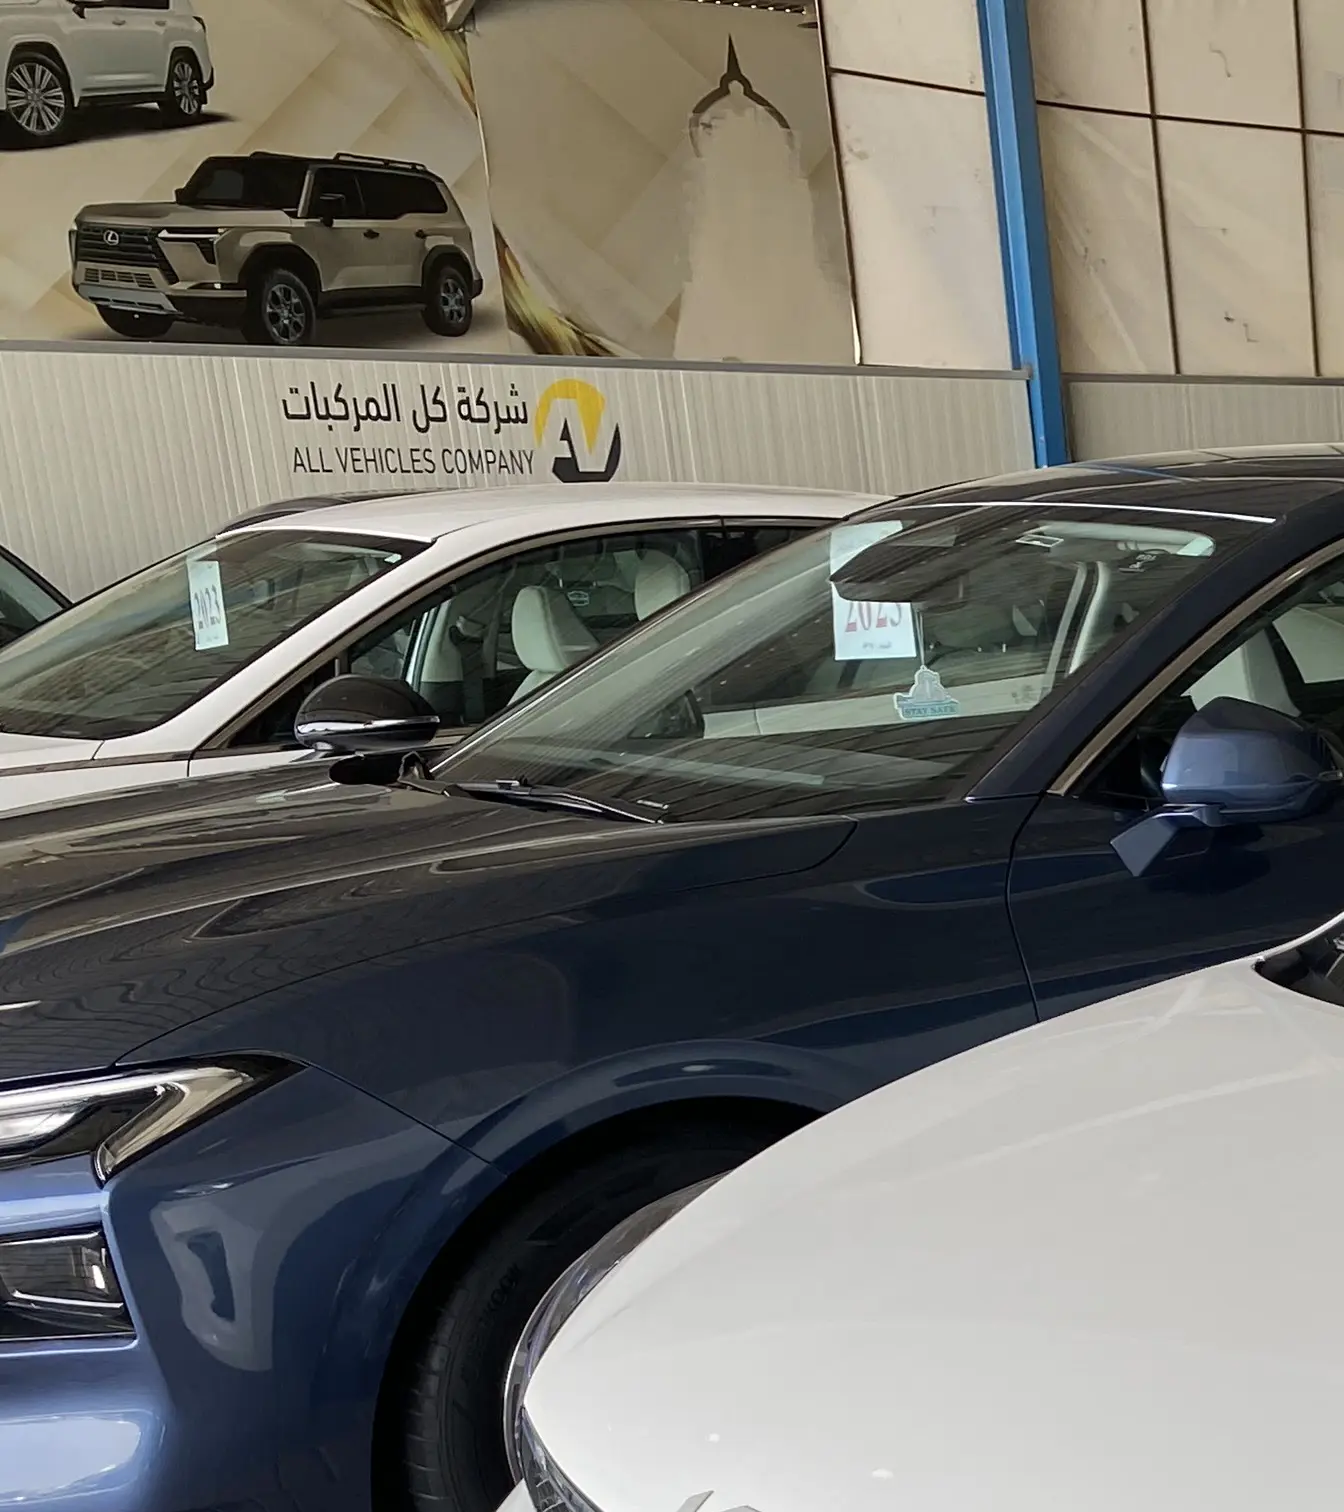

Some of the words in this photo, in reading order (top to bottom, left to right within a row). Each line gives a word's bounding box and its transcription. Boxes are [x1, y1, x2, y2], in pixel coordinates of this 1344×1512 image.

[281, 381, 402, 433] المركبات
[412, 384, 448, 434] كل
[457, 382, 528, 435] شركة
[293, 446, 334, 474] ALL
[335, 446, 436, 475] VEHICLES
[441, 447, 534, 476] COMPANY
